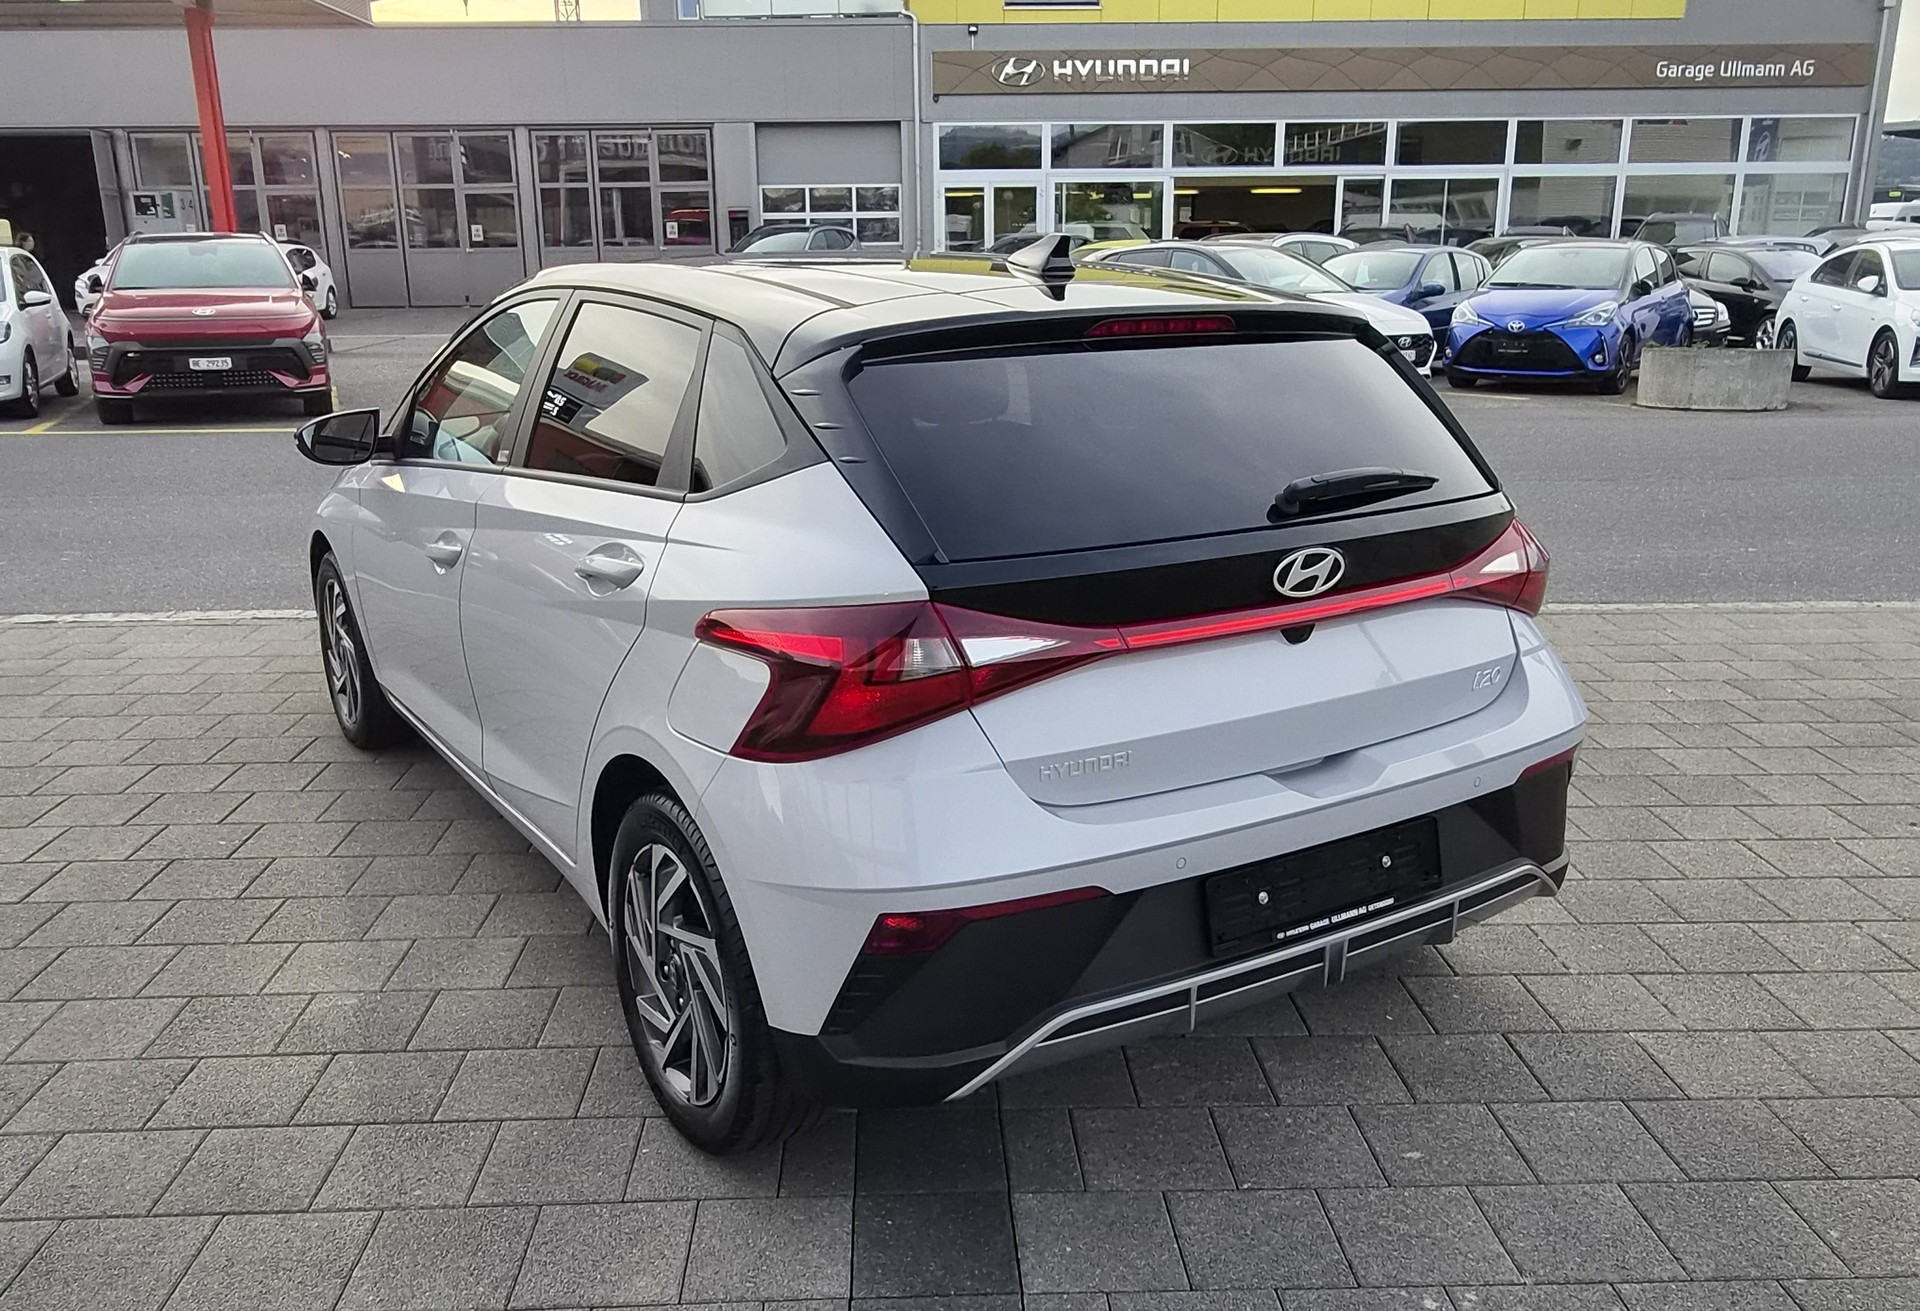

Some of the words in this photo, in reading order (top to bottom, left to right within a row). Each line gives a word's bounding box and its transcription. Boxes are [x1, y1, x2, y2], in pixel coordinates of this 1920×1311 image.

[1052, 58, 1190, 82] HYUNDAI
[1656, 61, 1715, 82] Garage
[1720, 60, 1785, 78] Ullmann
[1790, 60, 1815, 77] AG
[1039, 750, 1132, 782] HYUNDAI
